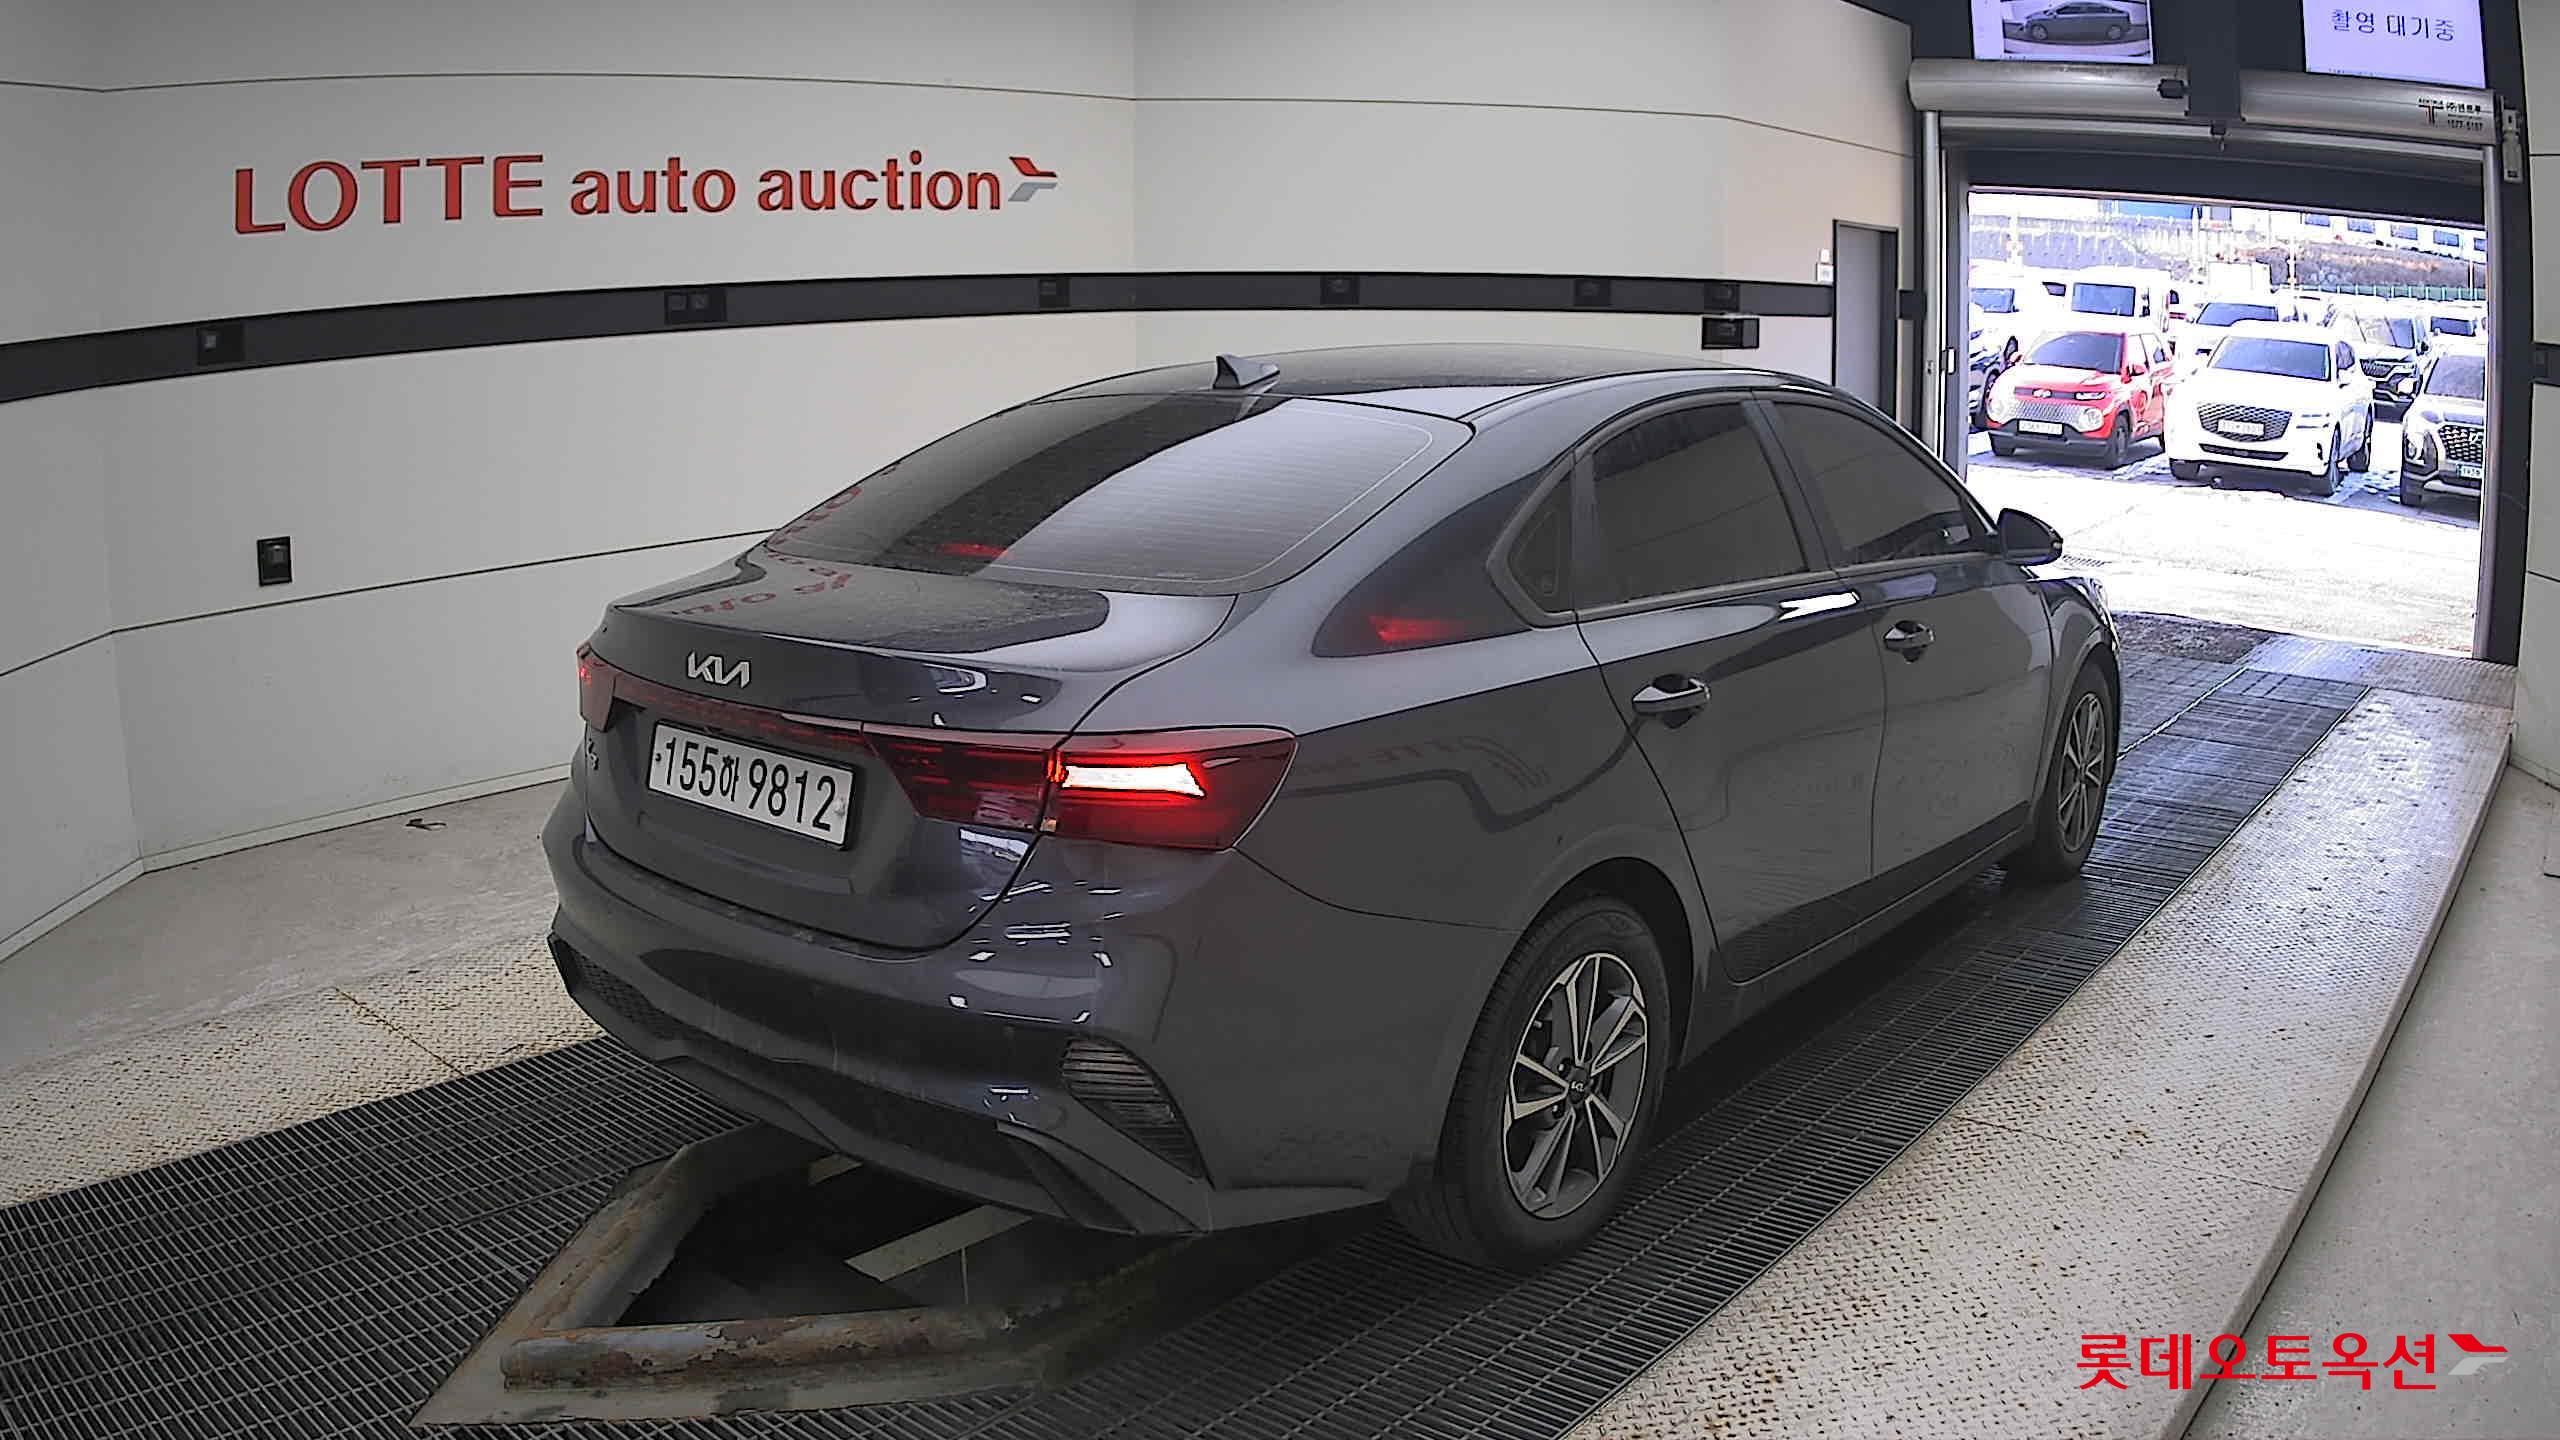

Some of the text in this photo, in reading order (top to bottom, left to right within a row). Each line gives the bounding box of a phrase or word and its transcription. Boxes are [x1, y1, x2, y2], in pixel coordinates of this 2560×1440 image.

[2331, 9, 2454, 42] 촬영 대기중
[234, 149, 1001, 235] LOTTE auto auction
